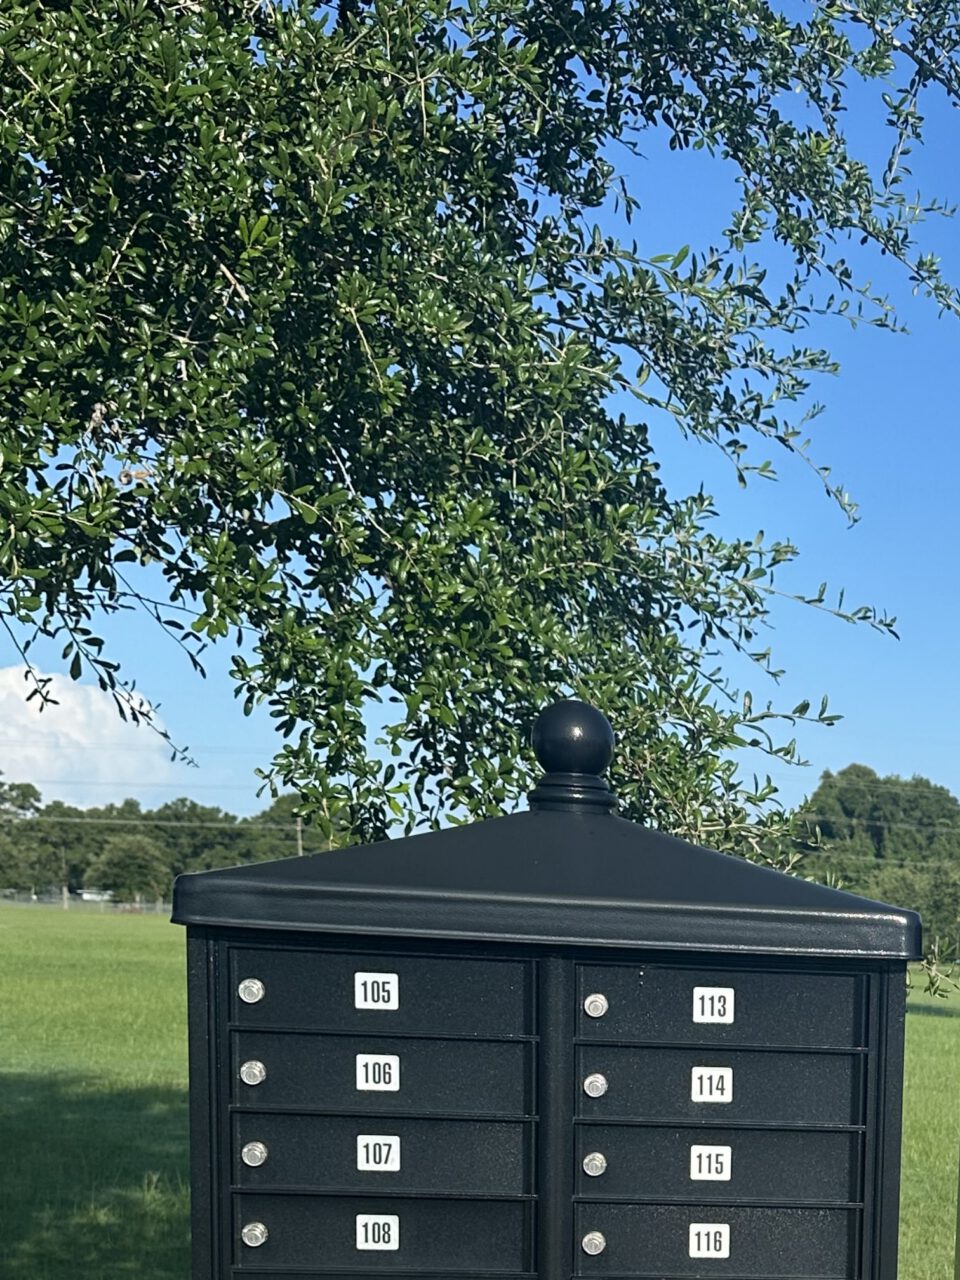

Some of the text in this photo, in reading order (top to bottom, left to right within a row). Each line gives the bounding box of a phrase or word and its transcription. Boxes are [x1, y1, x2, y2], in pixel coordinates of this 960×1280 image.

[360, 980, 391, 1004] 105
[698, 994, 727, 1018] 113
[362, 1061, 392, 1085] 106
[697, 1074, 726, 1096] 114
[362, 1142, 393, 1165] 107
[696, 1152, 724, 1175] 115
[361, 1221, 391, 1245] 108
[694, 1230, 723, 1253] 116
